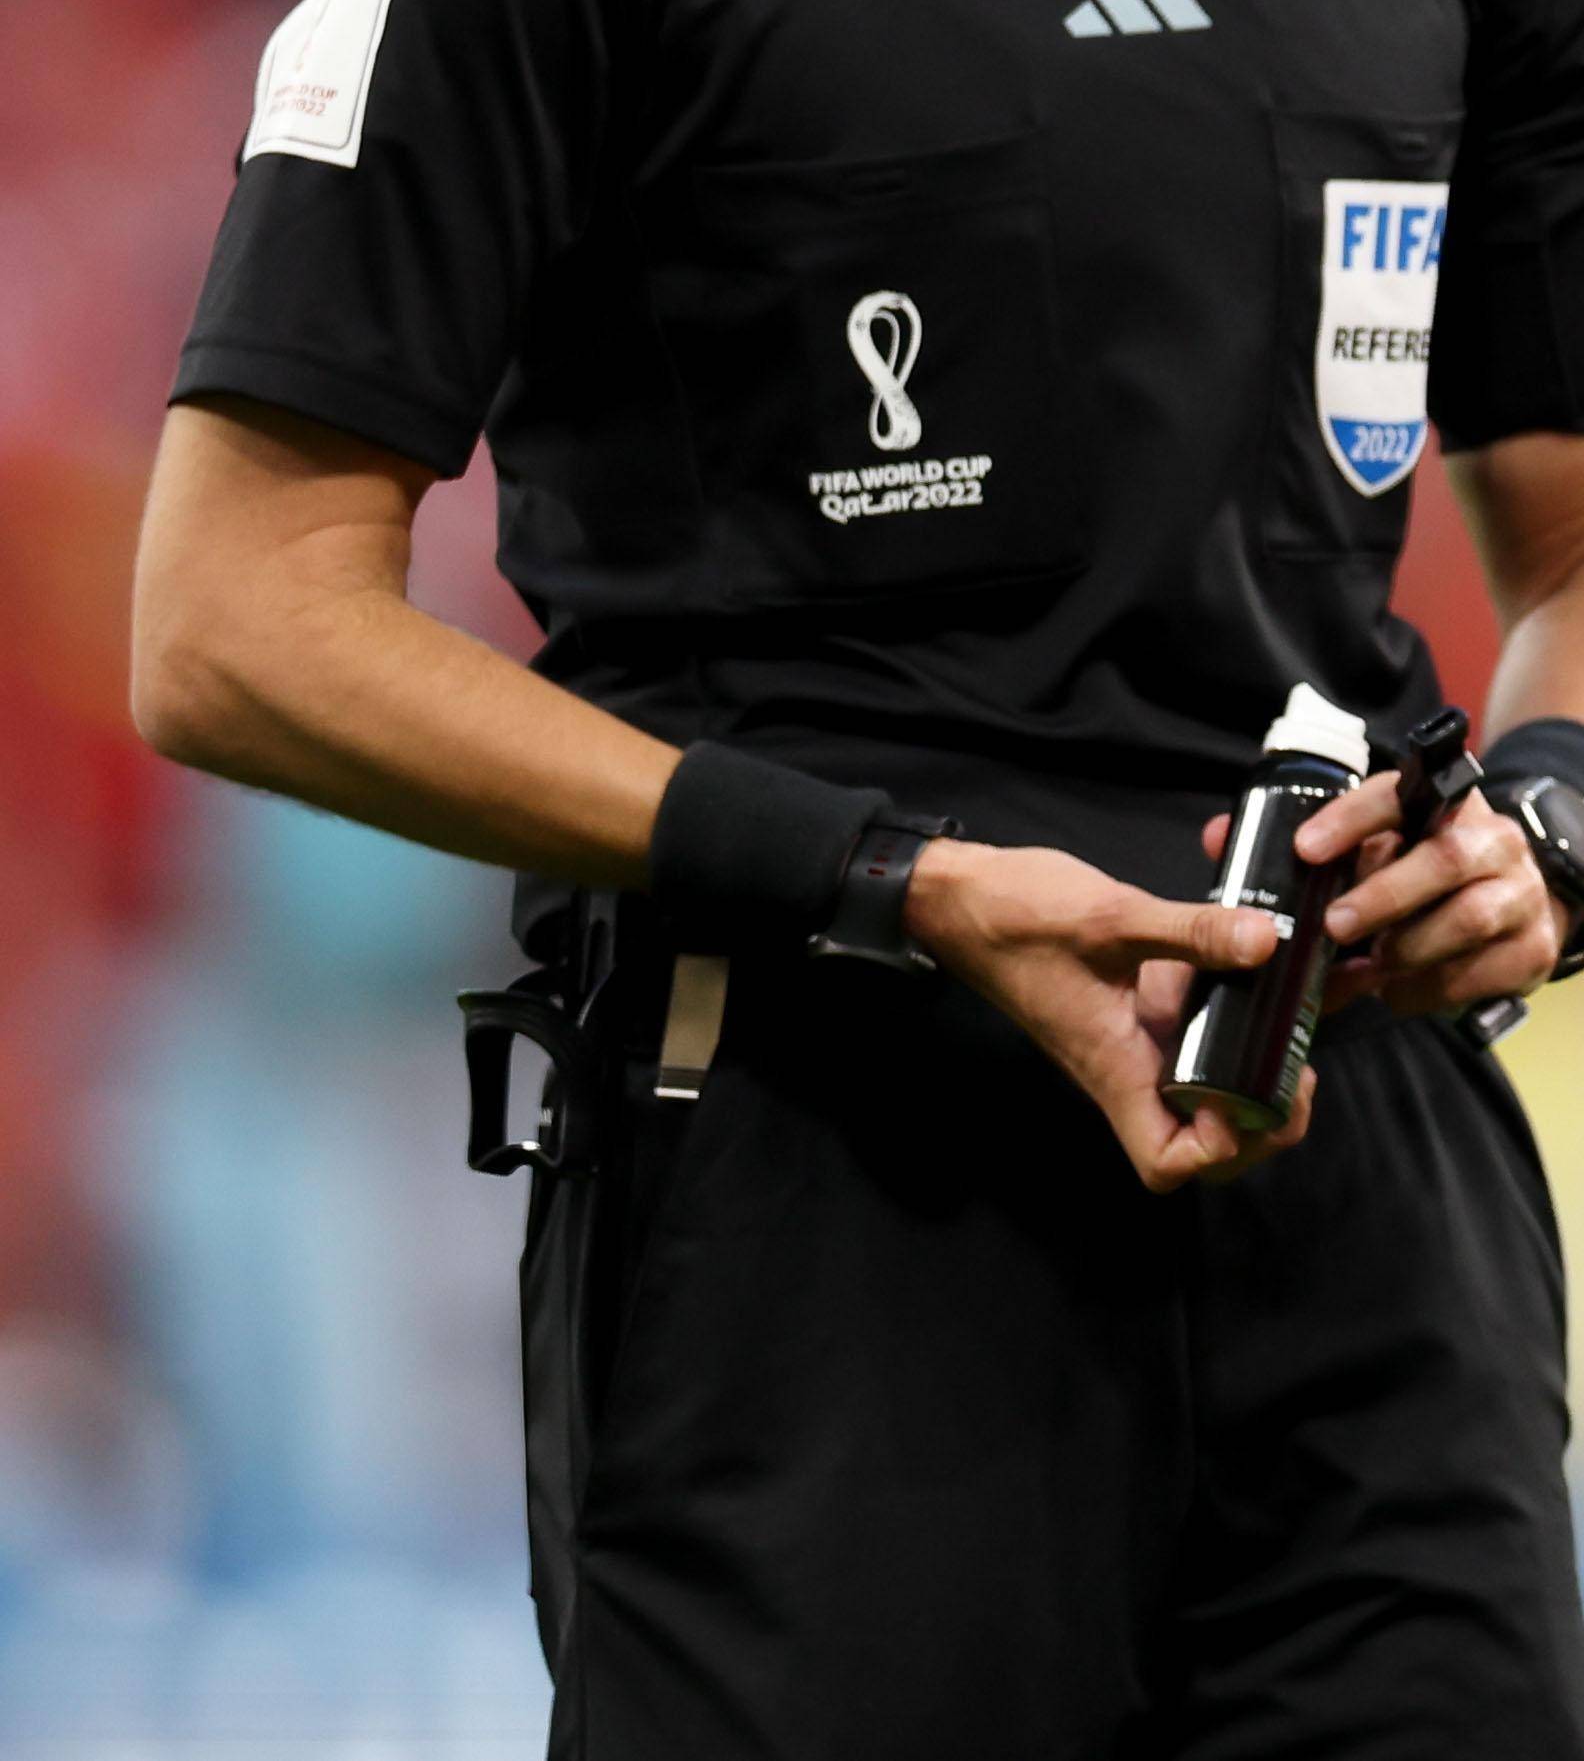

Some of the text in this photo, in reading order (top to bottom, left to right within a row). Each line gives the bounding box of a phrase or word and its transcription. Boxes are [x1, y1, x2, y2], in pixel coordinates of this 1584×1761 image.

[809, 455, 992, 495] FIFA WORLD CUP
[911, 479, 983, 510] 2022
